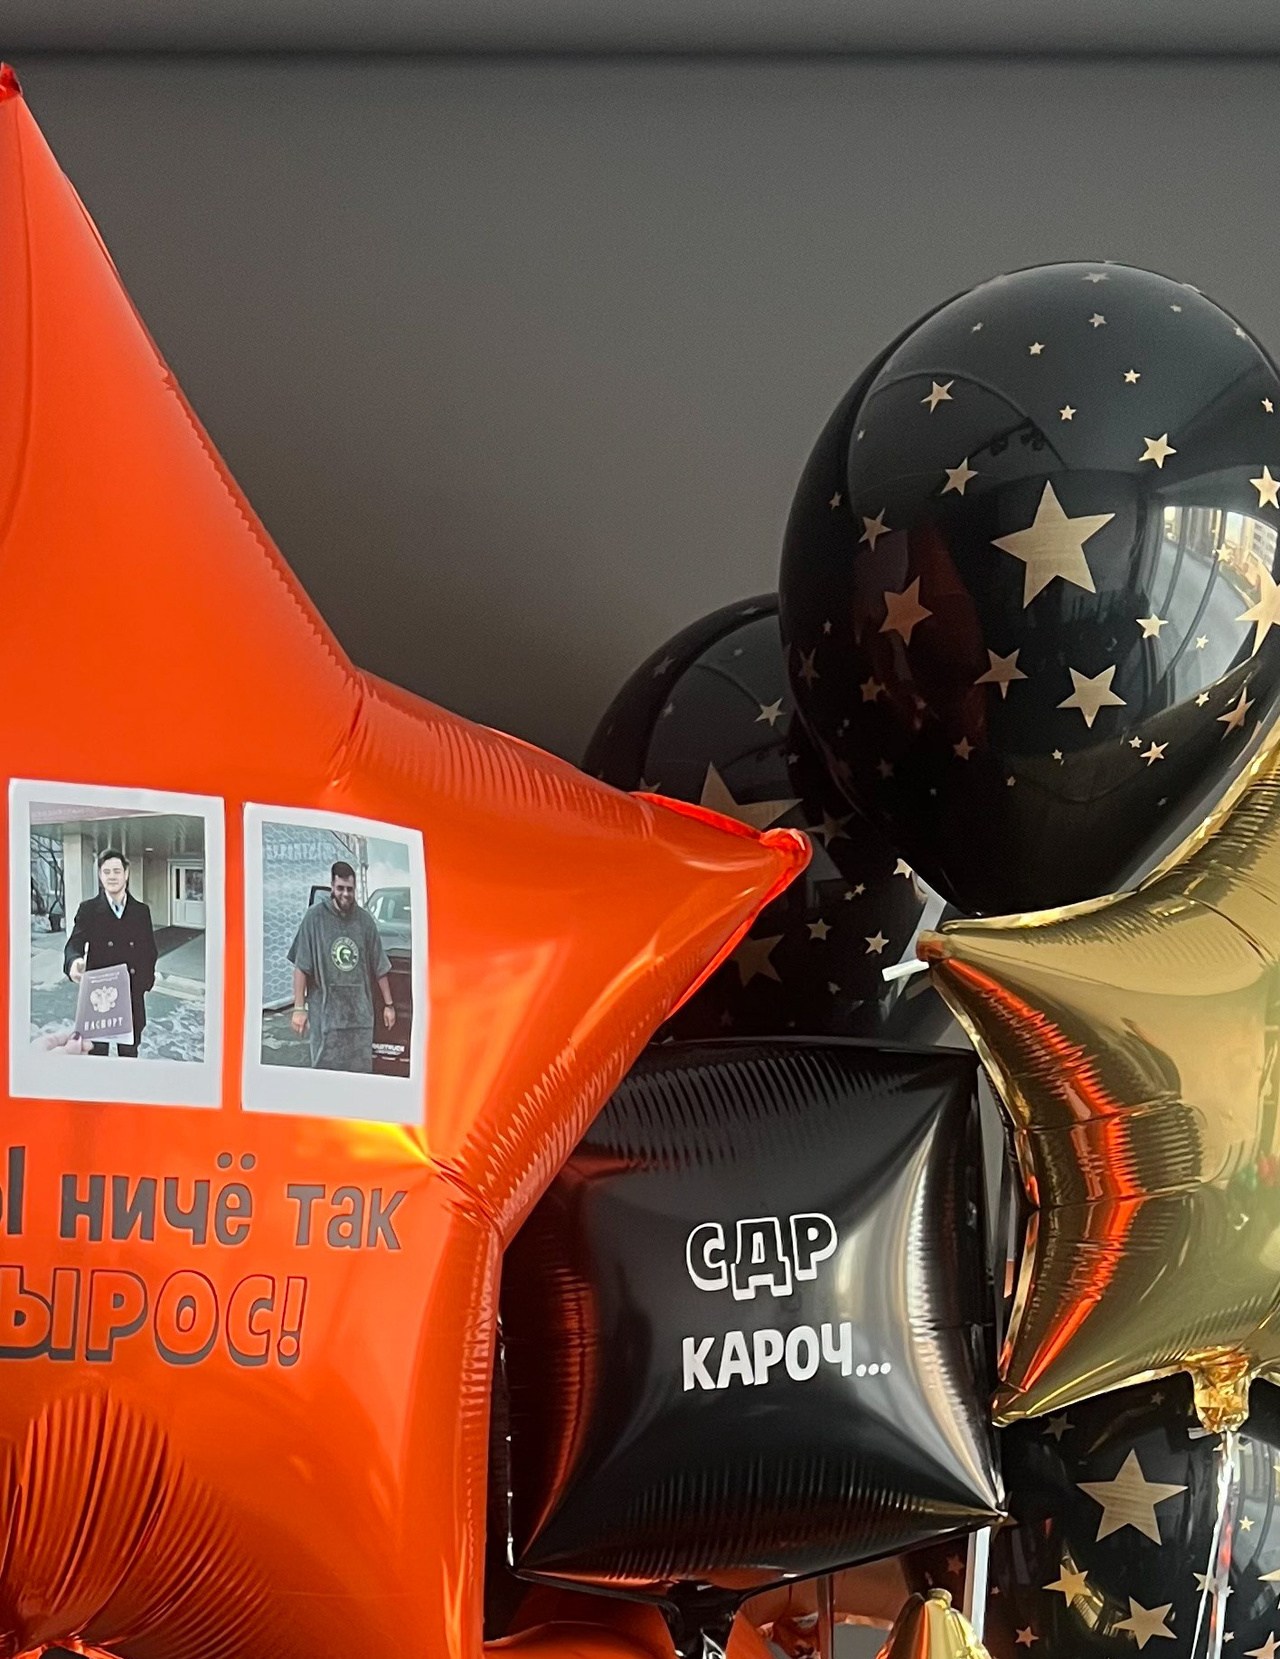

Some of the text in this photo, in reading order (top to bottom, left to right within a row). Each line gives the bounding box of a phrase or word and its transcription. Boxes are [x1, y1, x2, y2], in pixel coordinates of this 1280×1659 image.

[59, 1151, 256, 1246] ничё
[286, 1183, 407, 1250] так
[686, 1212, 838, 1301] СДР
[682, 1321, 891, 1392] КАРОЧ...
